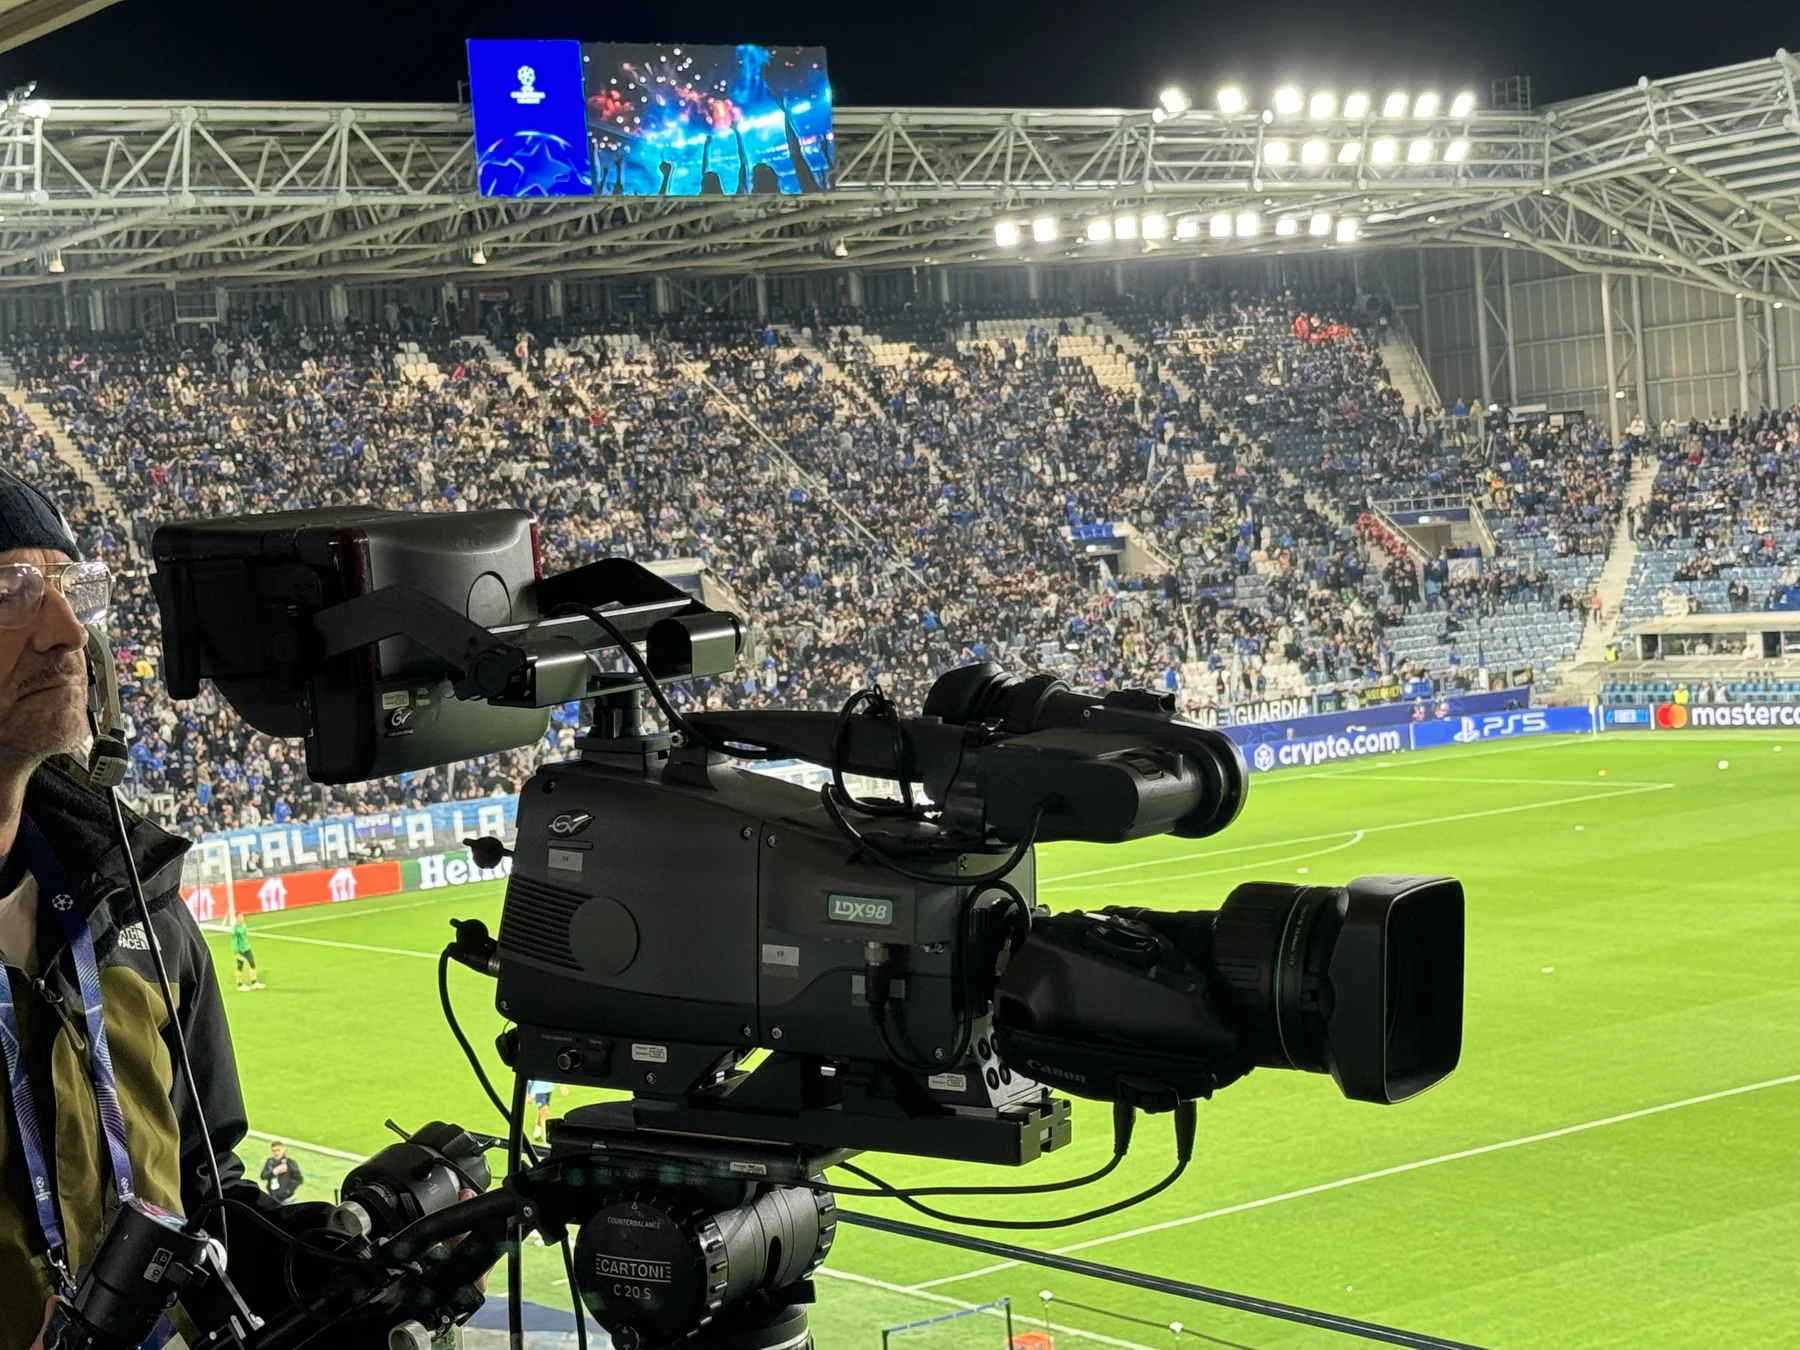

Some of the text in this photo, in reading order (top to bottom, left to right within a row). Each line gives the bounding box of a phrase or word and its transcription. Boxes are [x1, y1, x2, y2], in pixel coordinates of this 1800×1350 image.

[1235, 697, 1308, 725] GUARDIA
[1483, 711, 1547, 737] PS5
[1278, 730, 1401, 766] crypto.com
[834, 900, 887, 920] LDX98
[1026, 1059, 1086, 1084] Canon
[607, 1216, 662, 1229] COUNTERBALANCE
[600, 1259, 664, 1279] CARTONI
[613, 1284, 652, 1300] C 20 S
